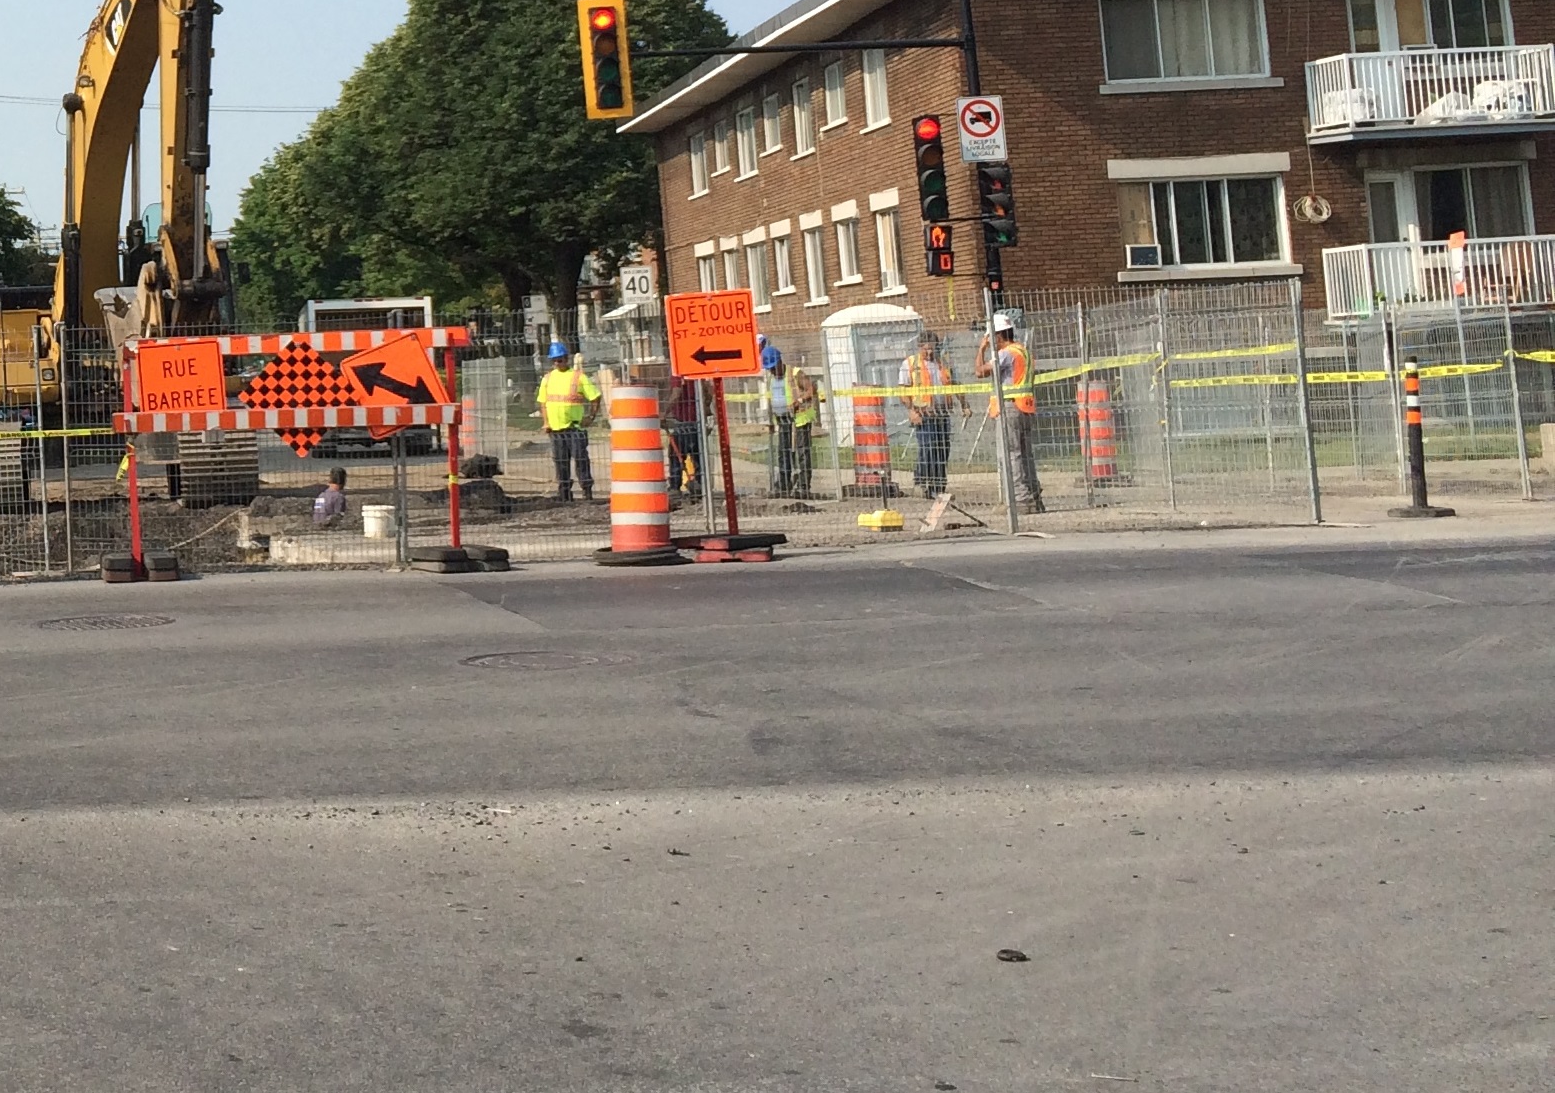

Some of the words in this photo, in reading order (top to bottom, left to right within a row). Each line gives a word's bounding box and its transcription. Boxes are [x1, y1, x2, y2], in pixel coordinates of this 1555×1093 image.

[625, 275, 650, 295] 40
[675, 300, 747, 325] DÉTOUR
[162, 357, 198, 379] RUE
[147, 384, 219, 411] BARRÉE
